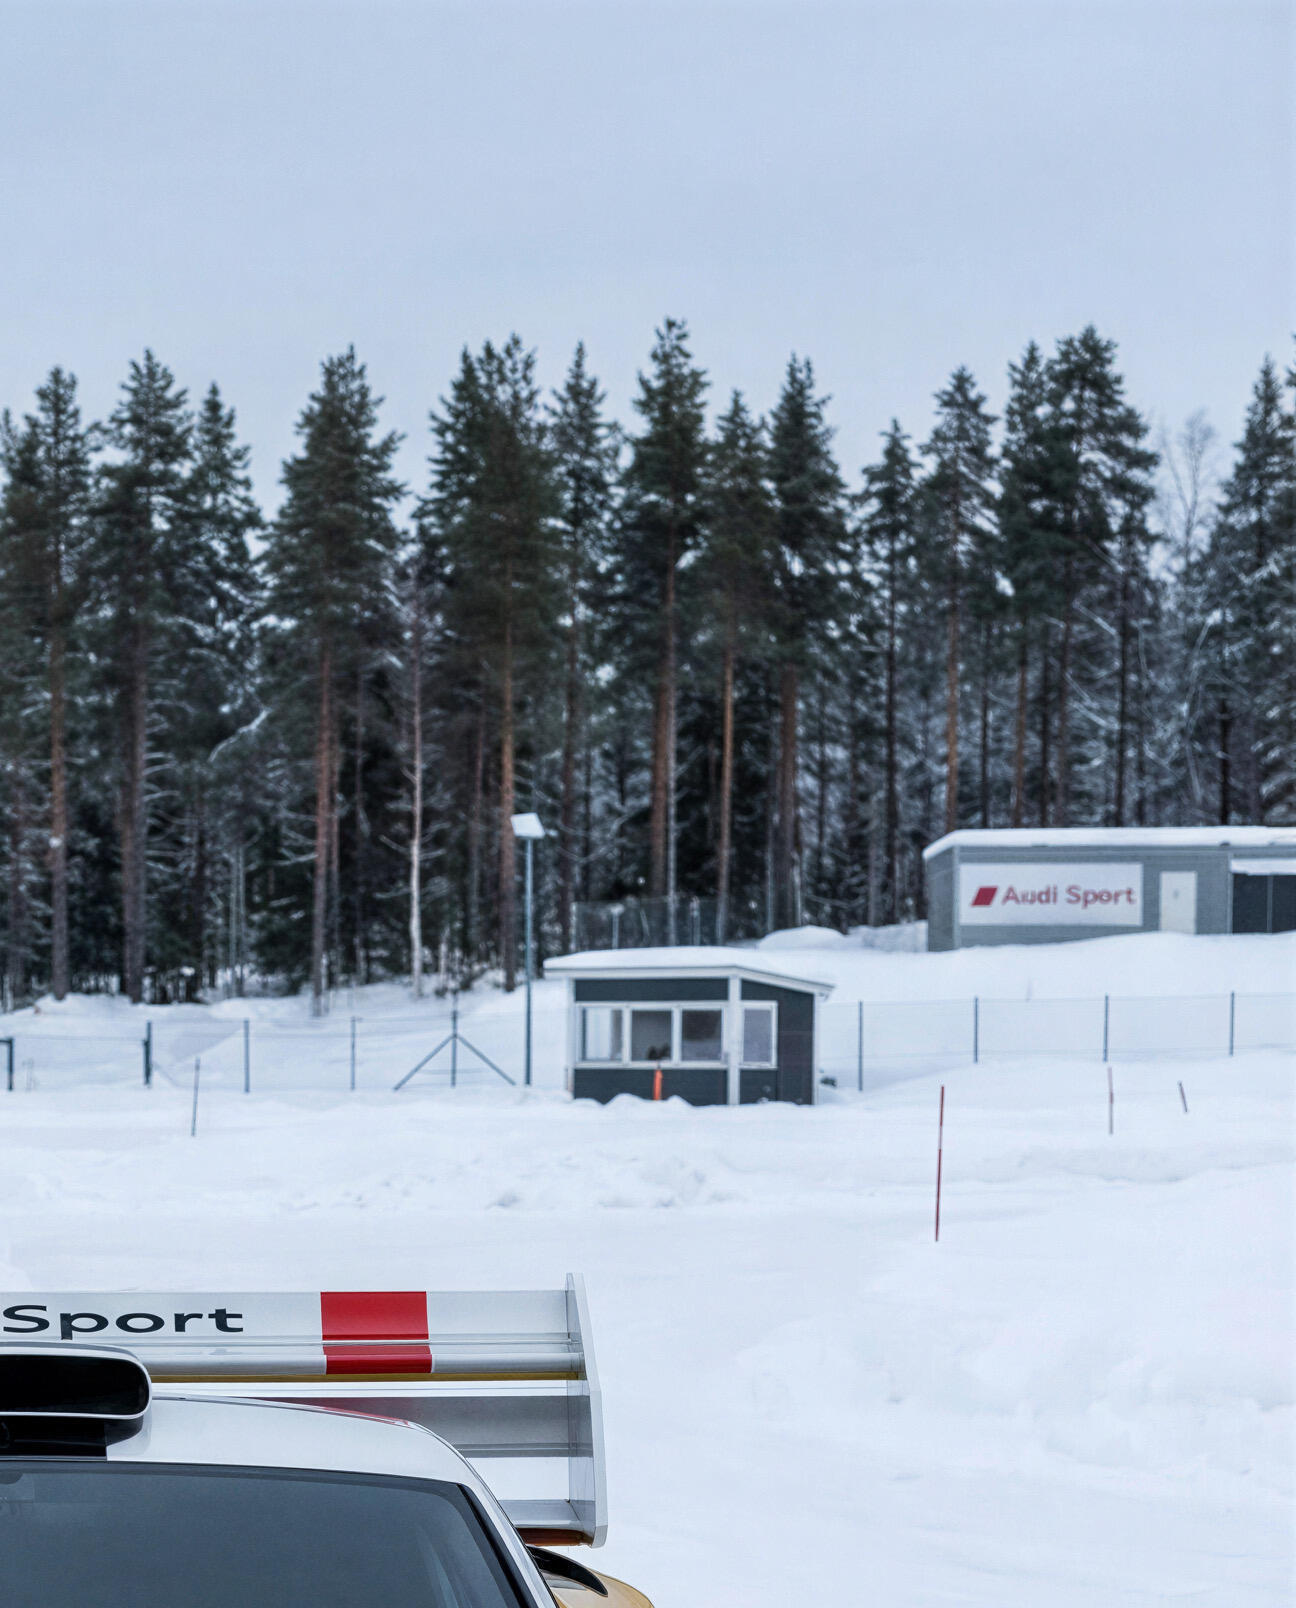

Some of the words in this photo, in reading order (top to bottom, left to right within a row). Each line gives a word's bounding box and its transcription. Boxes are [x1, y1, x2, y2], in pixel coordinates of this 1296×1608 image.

[1001, 885, 1058, 905] Audi
[1065, 885, 1136, 909] Sport
[2, 1304, 245, 1341] Sport
